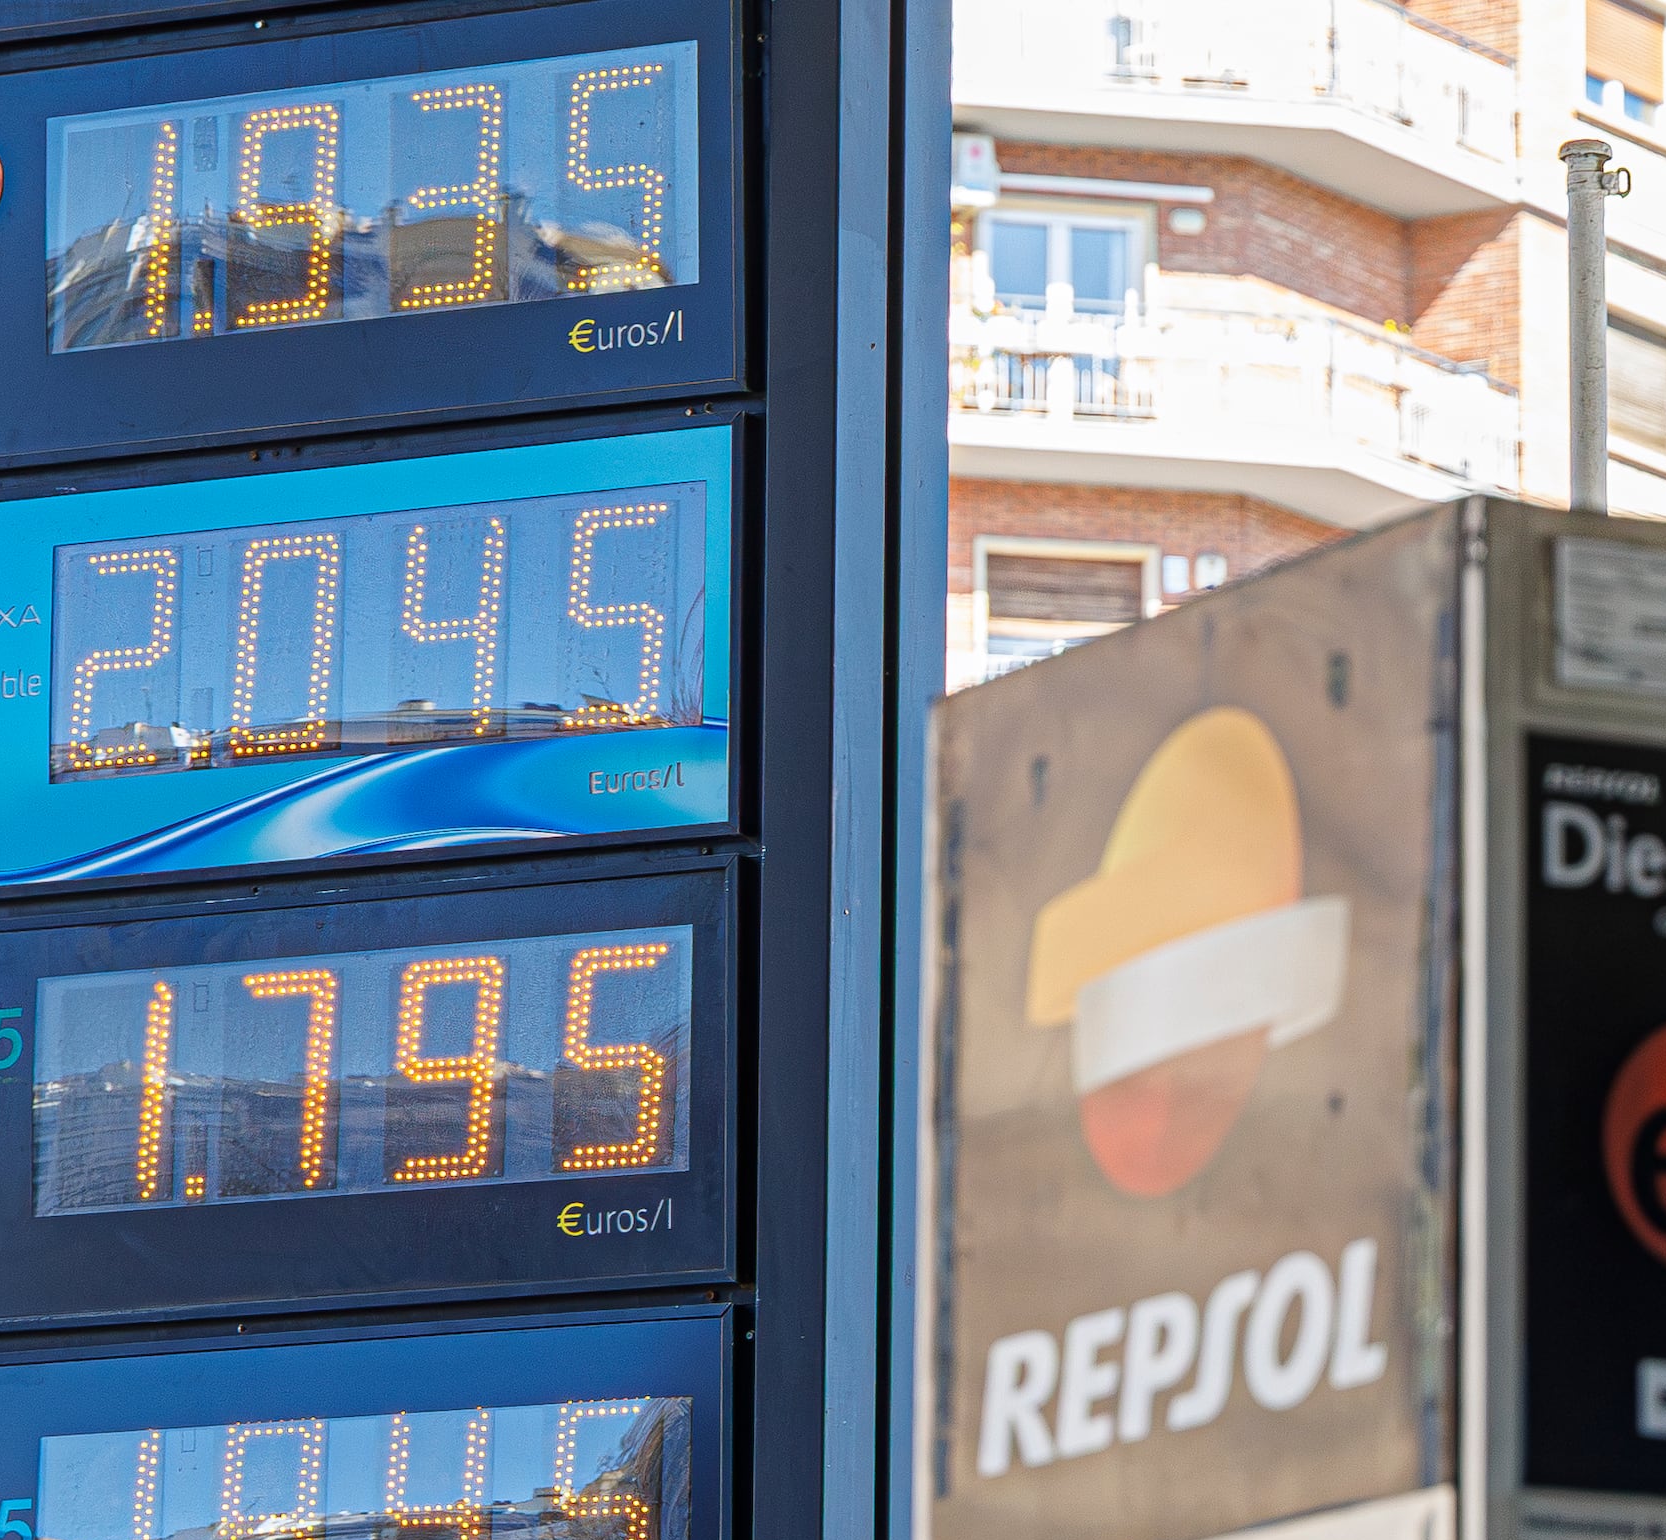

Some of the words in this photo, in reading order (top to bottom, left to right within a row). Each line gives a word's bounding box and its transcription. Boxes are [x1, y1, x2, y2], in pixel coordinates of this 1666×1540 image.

[144, 64, 664, 338] 1.935
[67, 504, 668, 769] 2.045
[588, 763, 685, 796] Euros/l
[140, 943, 669, 1200] 1.795
[976, 1237, 1388, 1480] REPSOL
